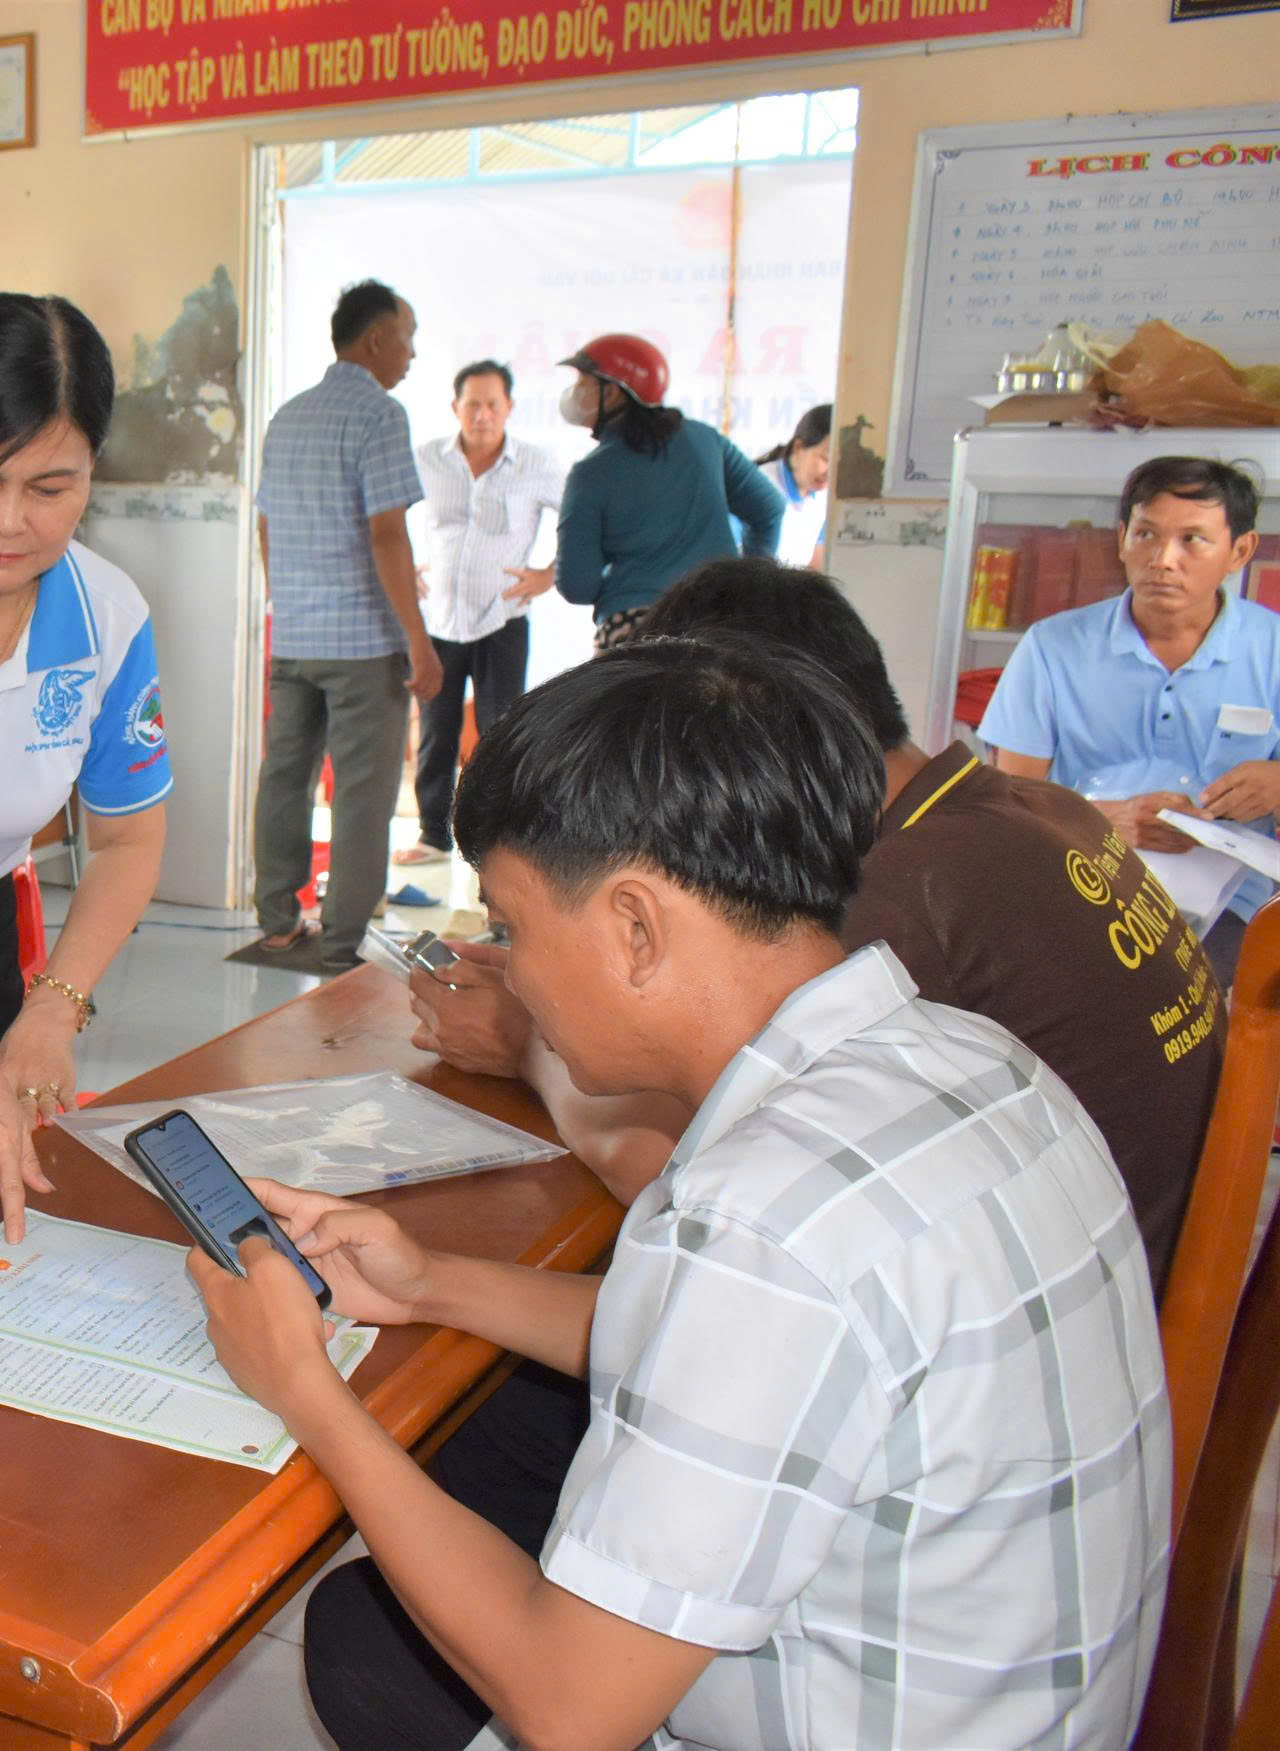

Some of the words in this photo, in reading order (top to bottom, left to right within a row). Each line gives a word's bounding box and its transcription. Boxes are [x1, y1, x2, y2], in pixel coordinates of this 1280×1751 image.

[176, 47, 216, 113] TẬP
[221, 40, 248, 99] VÀ
[254, 36, 300, 96] LÀM
[306, 37, 364, 90] THEO
[370, 22, 403, 81] TƯ
[406, 7, 489, 79] TƯỞNG,
[497, 13, 549, 76] ĐẠO
[623, 0, 712, 52] PHONG
[1027, 153, 1151, 179] LỊCH
[1165, 141, 1280, 170] CÔN
[1108, 891, 1170, 970] CÔNG
[1150, 1006, 1183, 1036] Khóm
